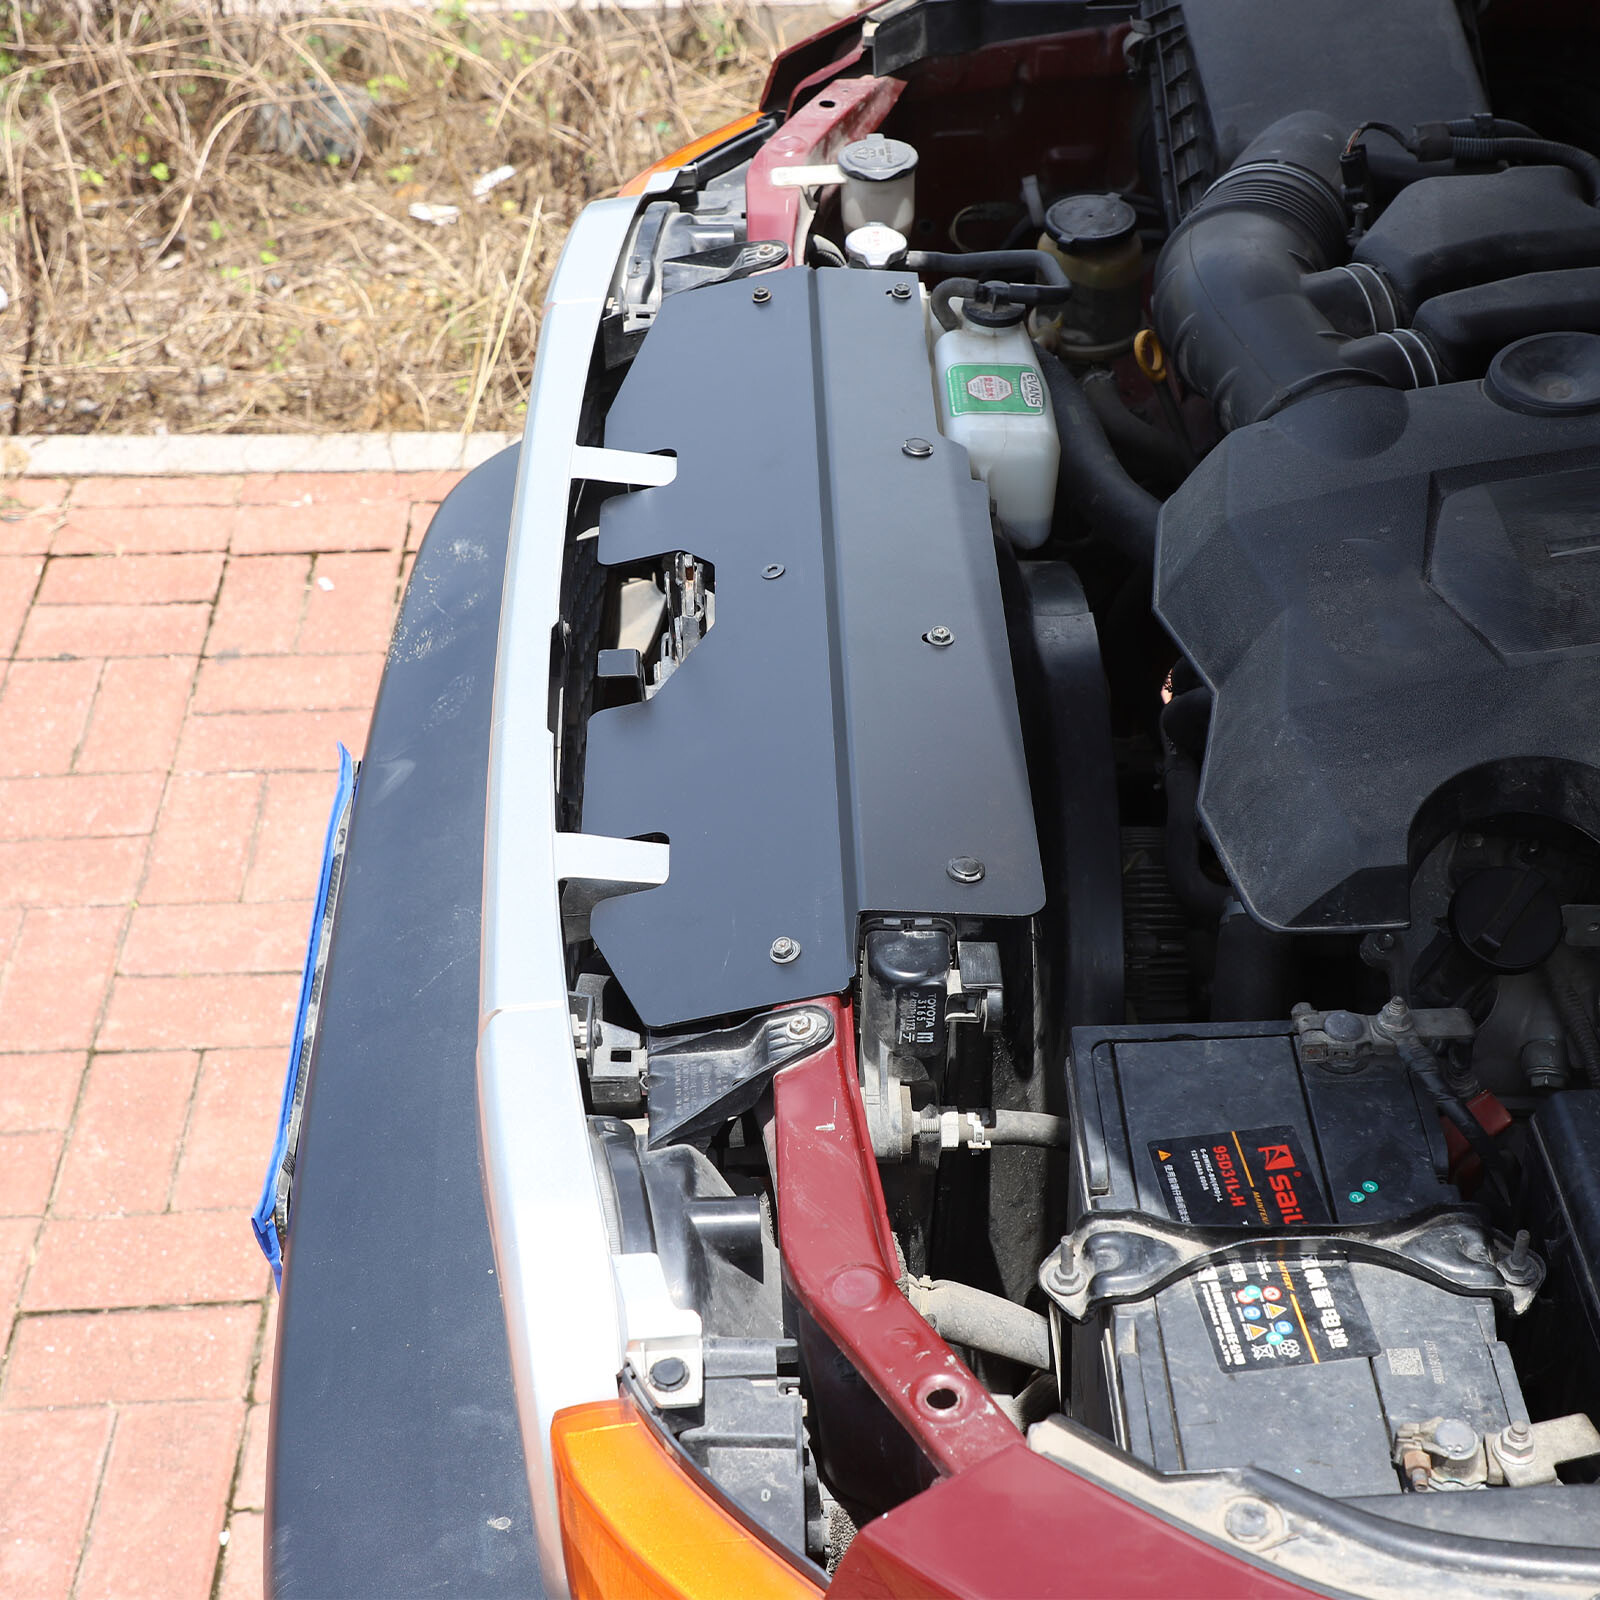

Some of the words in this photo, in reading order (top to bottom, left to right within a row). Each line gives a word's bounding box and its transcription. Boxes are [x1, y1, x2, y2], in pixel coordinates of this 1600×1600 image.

[1026, 374, 1042, 407] EVANS
[916, 999, 927, 1022] 3165
[925, 993, 936, 1028] TOYOTA
[1213, 1145, 1247, 1206] 95D31L-H
